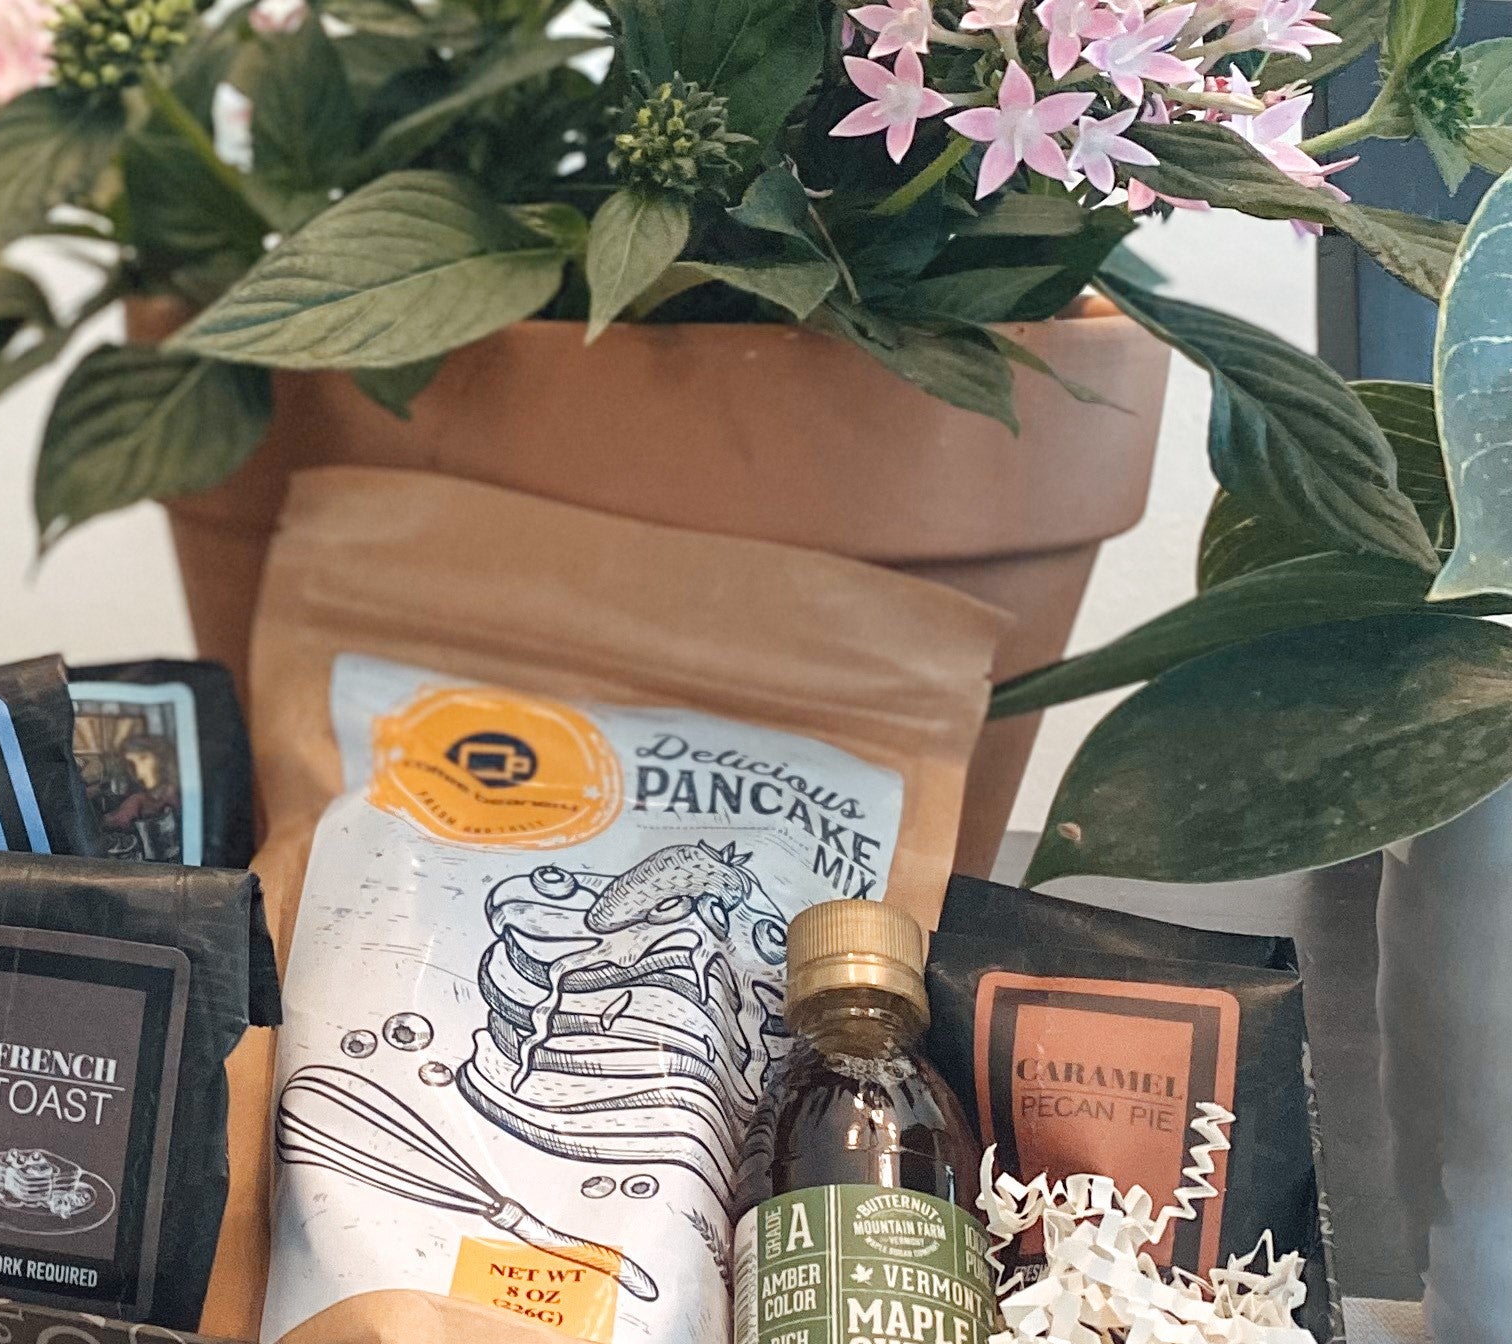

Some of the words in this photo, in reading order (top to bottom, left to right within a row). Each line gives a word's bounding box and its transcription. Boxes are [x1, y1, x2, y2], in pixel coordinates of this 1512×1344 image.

[635, 734, 866, 820] Delicious
[632, 765, 881, 876] PANCAKE
[813, 844, 877, 901] MIX
[1016, 1058, 1183, 1101] CARAMEL
[1020, 1094, 1115, 1122] PECAN
[1129, 1105, 1176, 1133] PIE
[857, 1193, 940, 1221] BUTTERNUT
[765, 1206, 782, 1261] GRADE
[786, 1202, 814, 1252] A
[853, 1219, 916, 1237] MOUNTAIN
[917, 1220, 947, 1241] FARM
[26, 1260, 98, 1288] REQUIRED
[489, 1263, 540, 1282] NET
[547, 1268, 587, 1283] WT
[762, 1263, 822, 1300] AMBER
[883, 1263, 984, 1320] VERMONT
[506, 1285, 519, 1298] 8
[525, 1288, 562, 1304] OZ
[764, 1288, 817, 1322] COLOR
